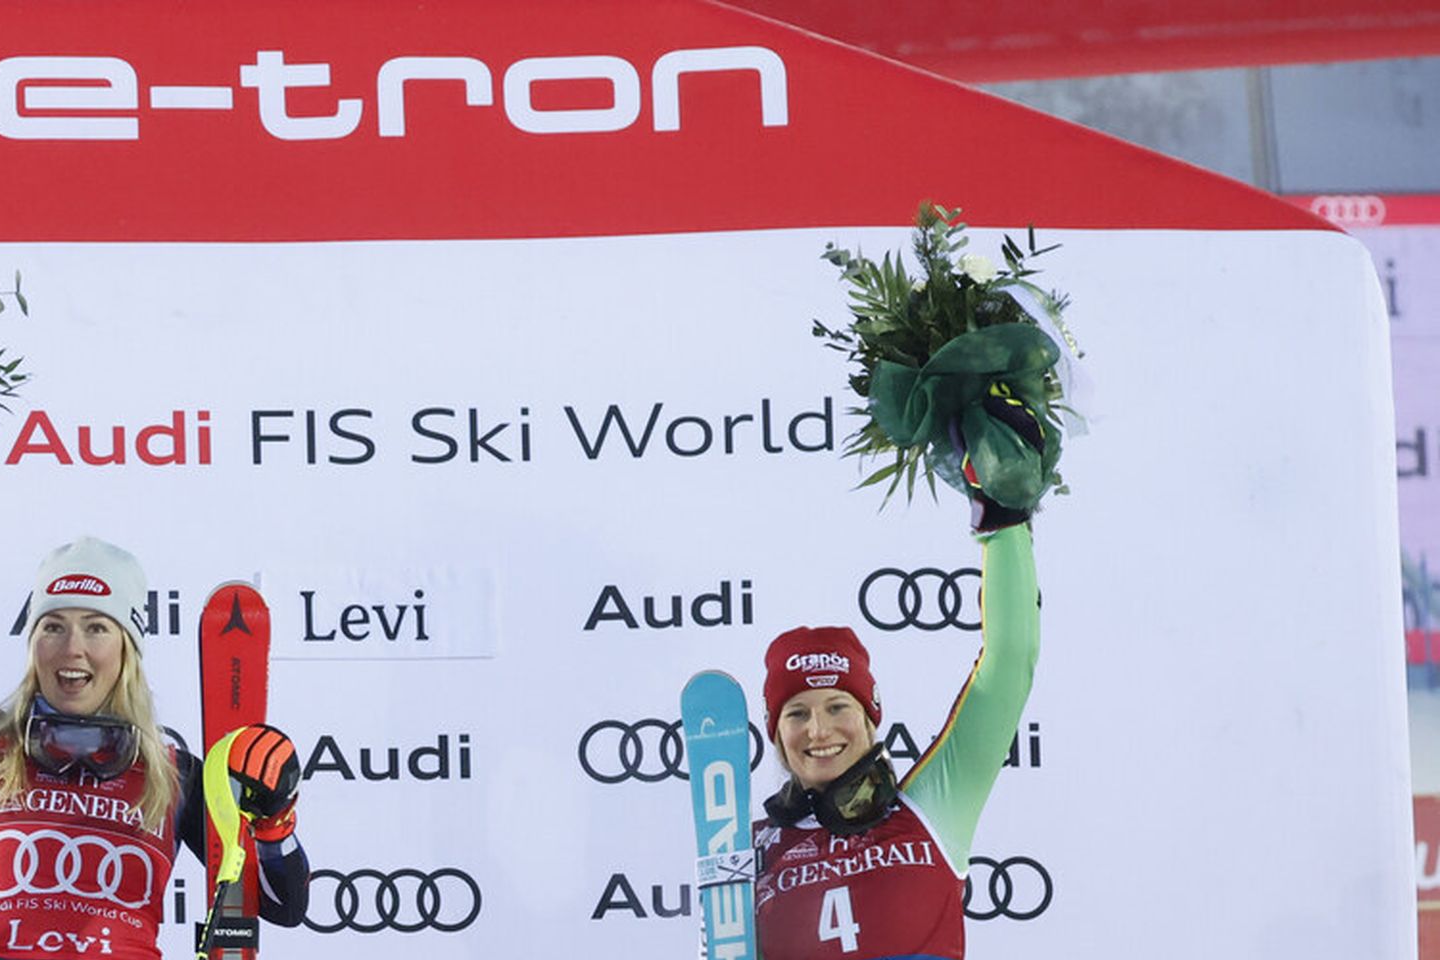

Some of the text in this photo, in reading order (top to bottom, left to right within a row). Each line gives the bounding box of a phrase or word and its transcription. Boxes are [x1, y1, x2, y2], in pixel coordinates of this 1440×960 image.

[5, 396, 834, 466] Audi FIS Ski World
[53, 578, 105, 594] Barilla
[583, 580, 753, 631] Audi
[299, 589, 429, 642] Levi
[301, 734, 471, 780] Audi
[777, 840, 936, 892] GENERALI
[16, 898, 39, 909] FIS
[44, 898, 67, 910] Ski
[71, 902, 117, 919] World
[120, 912, 143, 928] Cup
[213, 928, 253, 937] ATOMIC
[818, 885, 860, 953] 4
